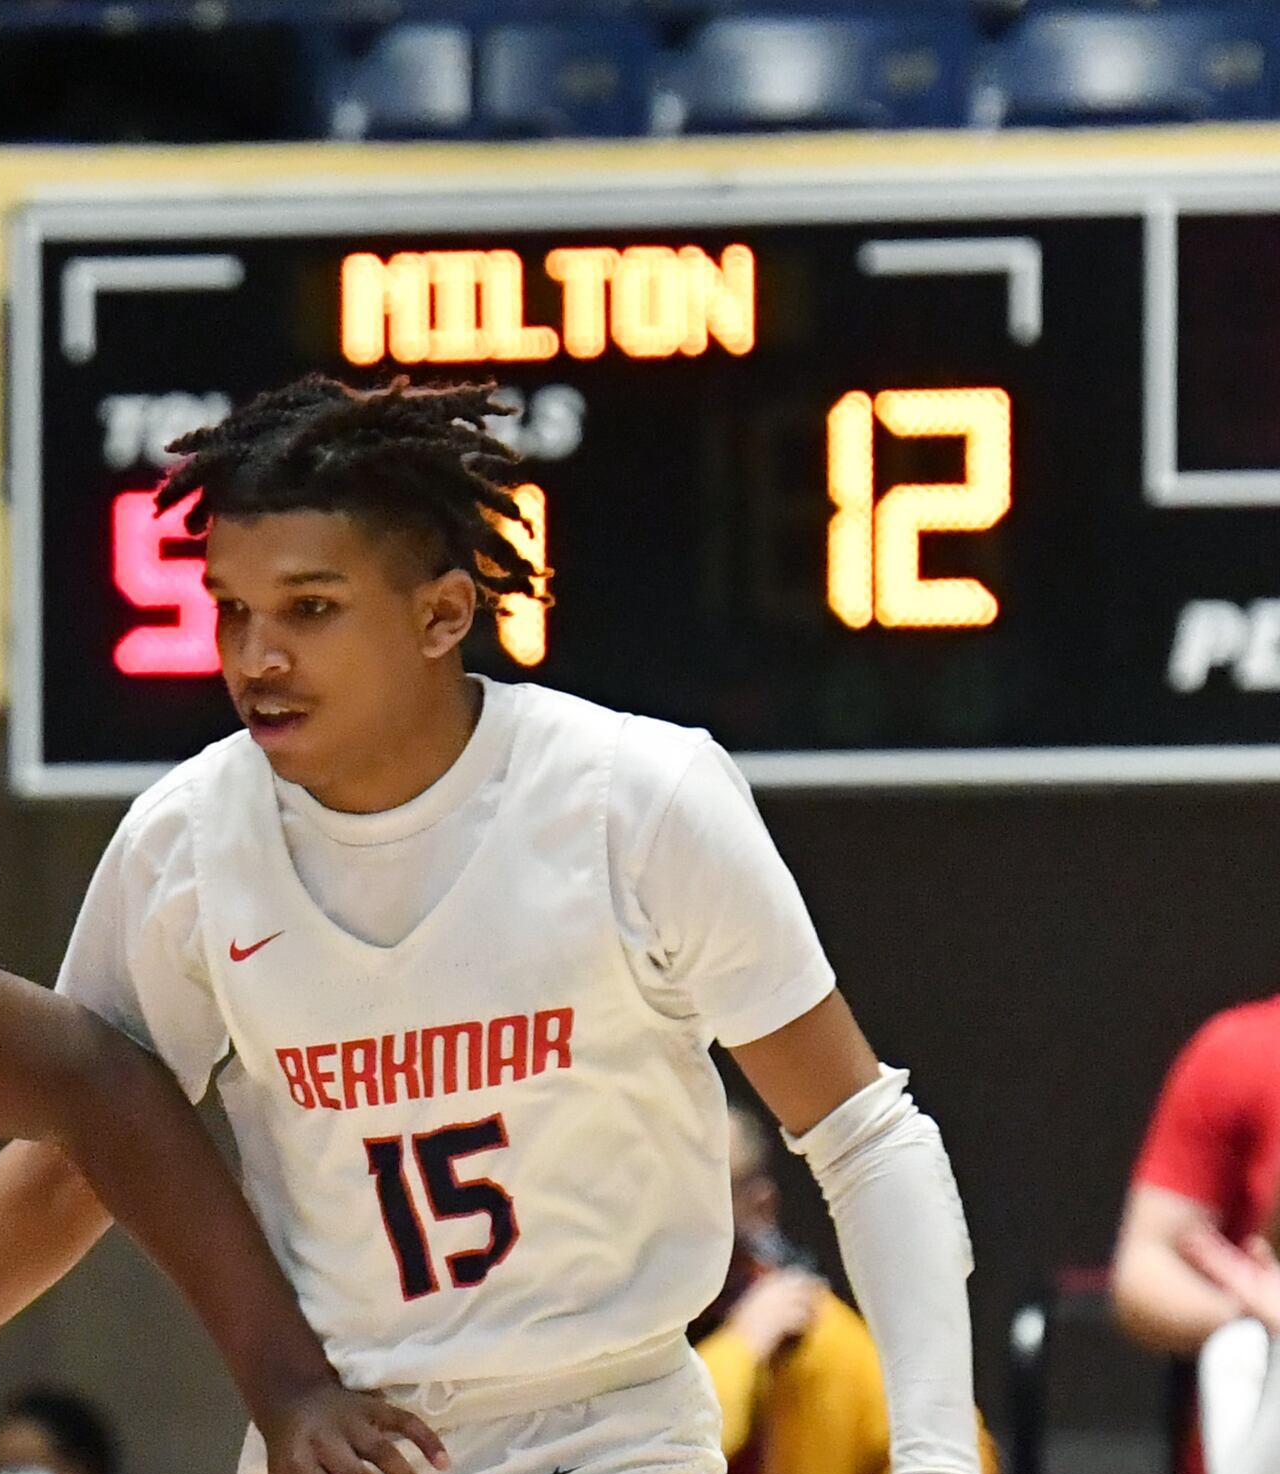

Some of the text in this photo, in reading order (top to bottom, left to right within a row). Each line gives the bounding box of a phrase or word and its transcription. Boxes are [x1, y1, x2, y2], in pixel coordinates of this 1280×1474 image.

[342, 243, 756, 365] MILTON
[827, 386, 1012, 630] 12
[275, 1007, 575, 1110] BERKMAR
[363, 1112, 521, 1302] 15
